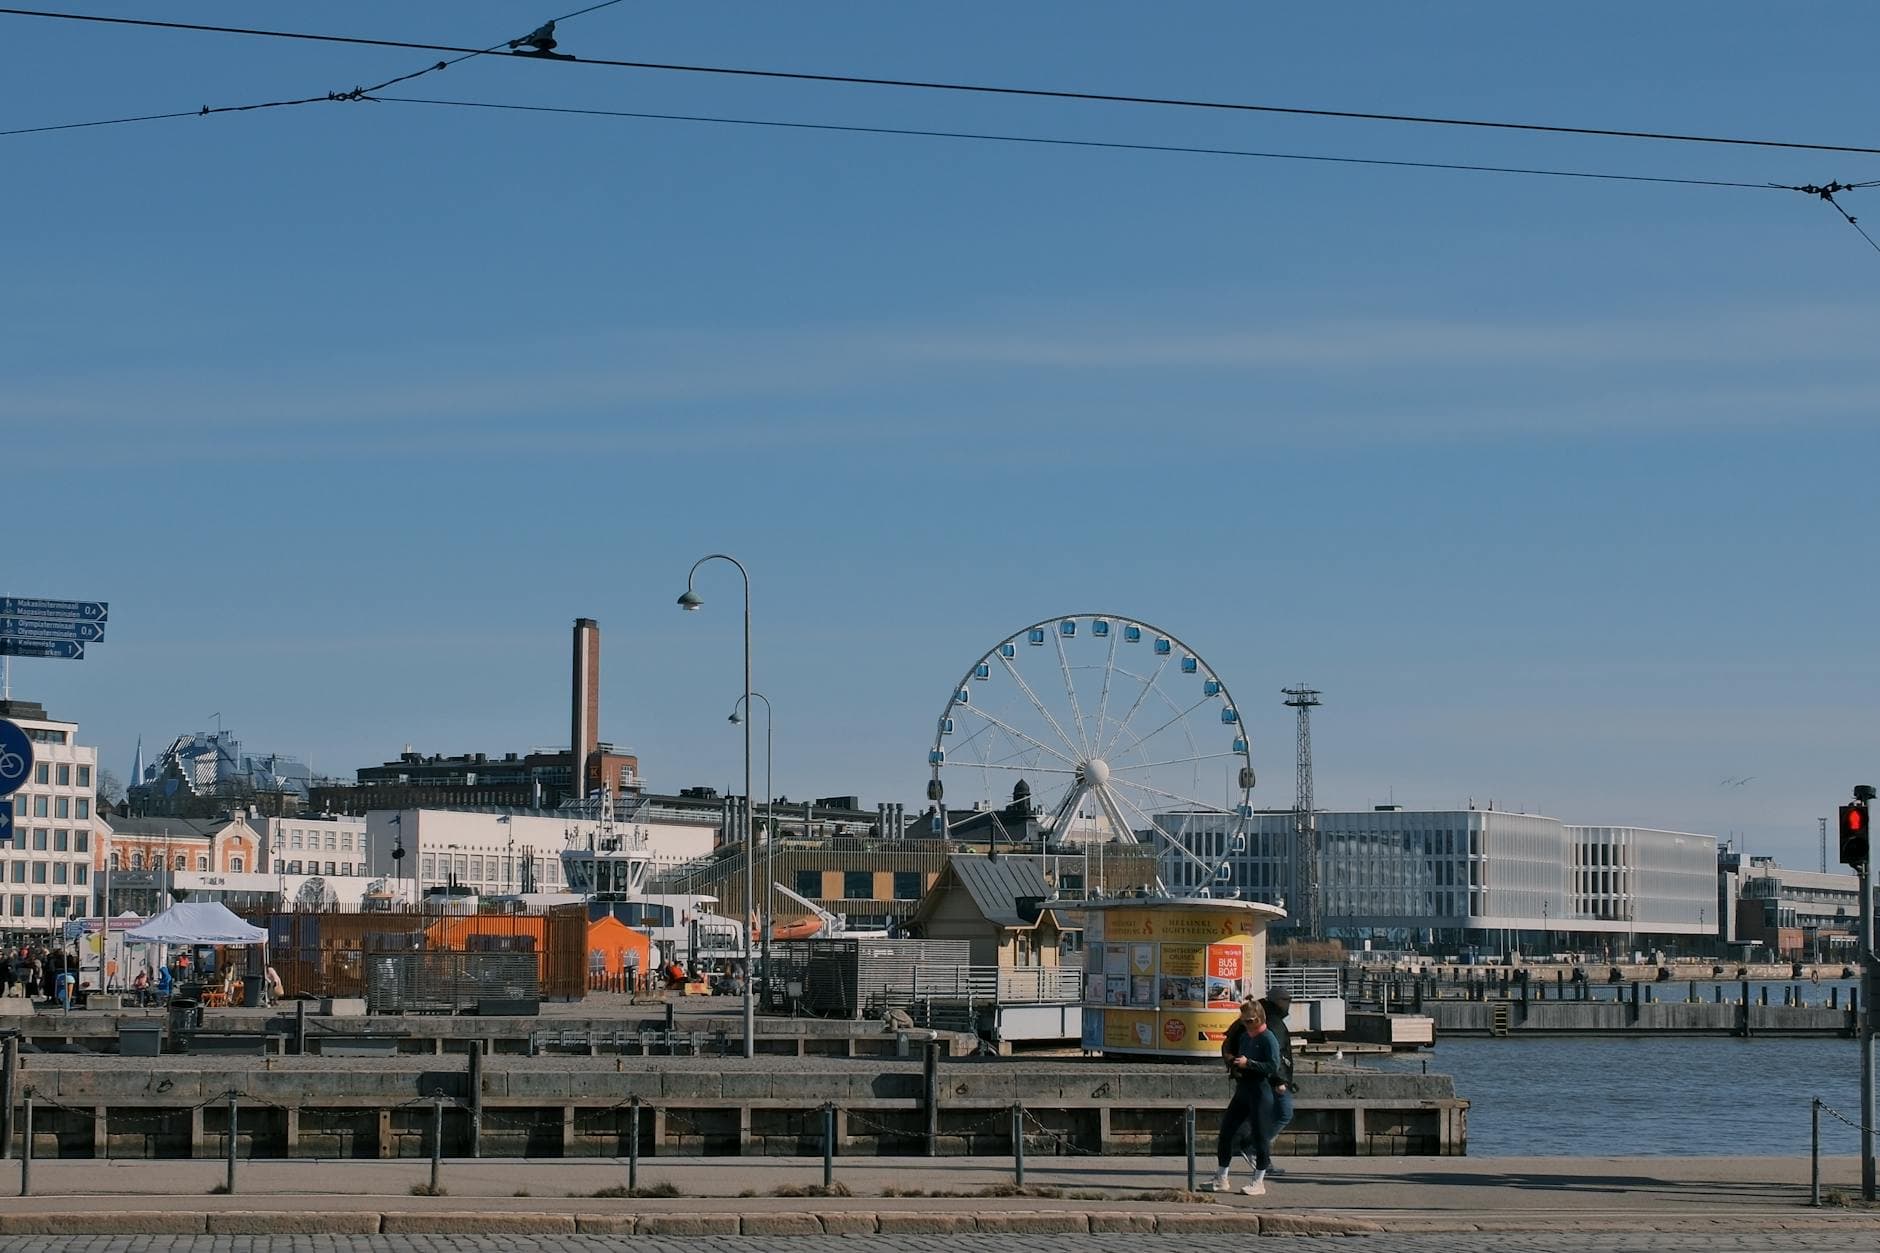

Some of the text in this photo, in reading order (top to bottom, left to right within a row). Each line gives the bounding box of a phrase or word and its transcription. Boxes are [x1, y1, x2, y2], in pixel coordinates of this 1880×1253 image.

[18, 620, 76, 630] Olympiaterminaali
[17, 627, 77, 638] Olympiaterminalen
[18, 639, 56, 648] Kaiuisto
[1168, 919, 1210, 927] HELSINKI
[1162, 927, 1218, 935] SIGHTSEEING
[1218, 967, 1238, 977] BOAT
